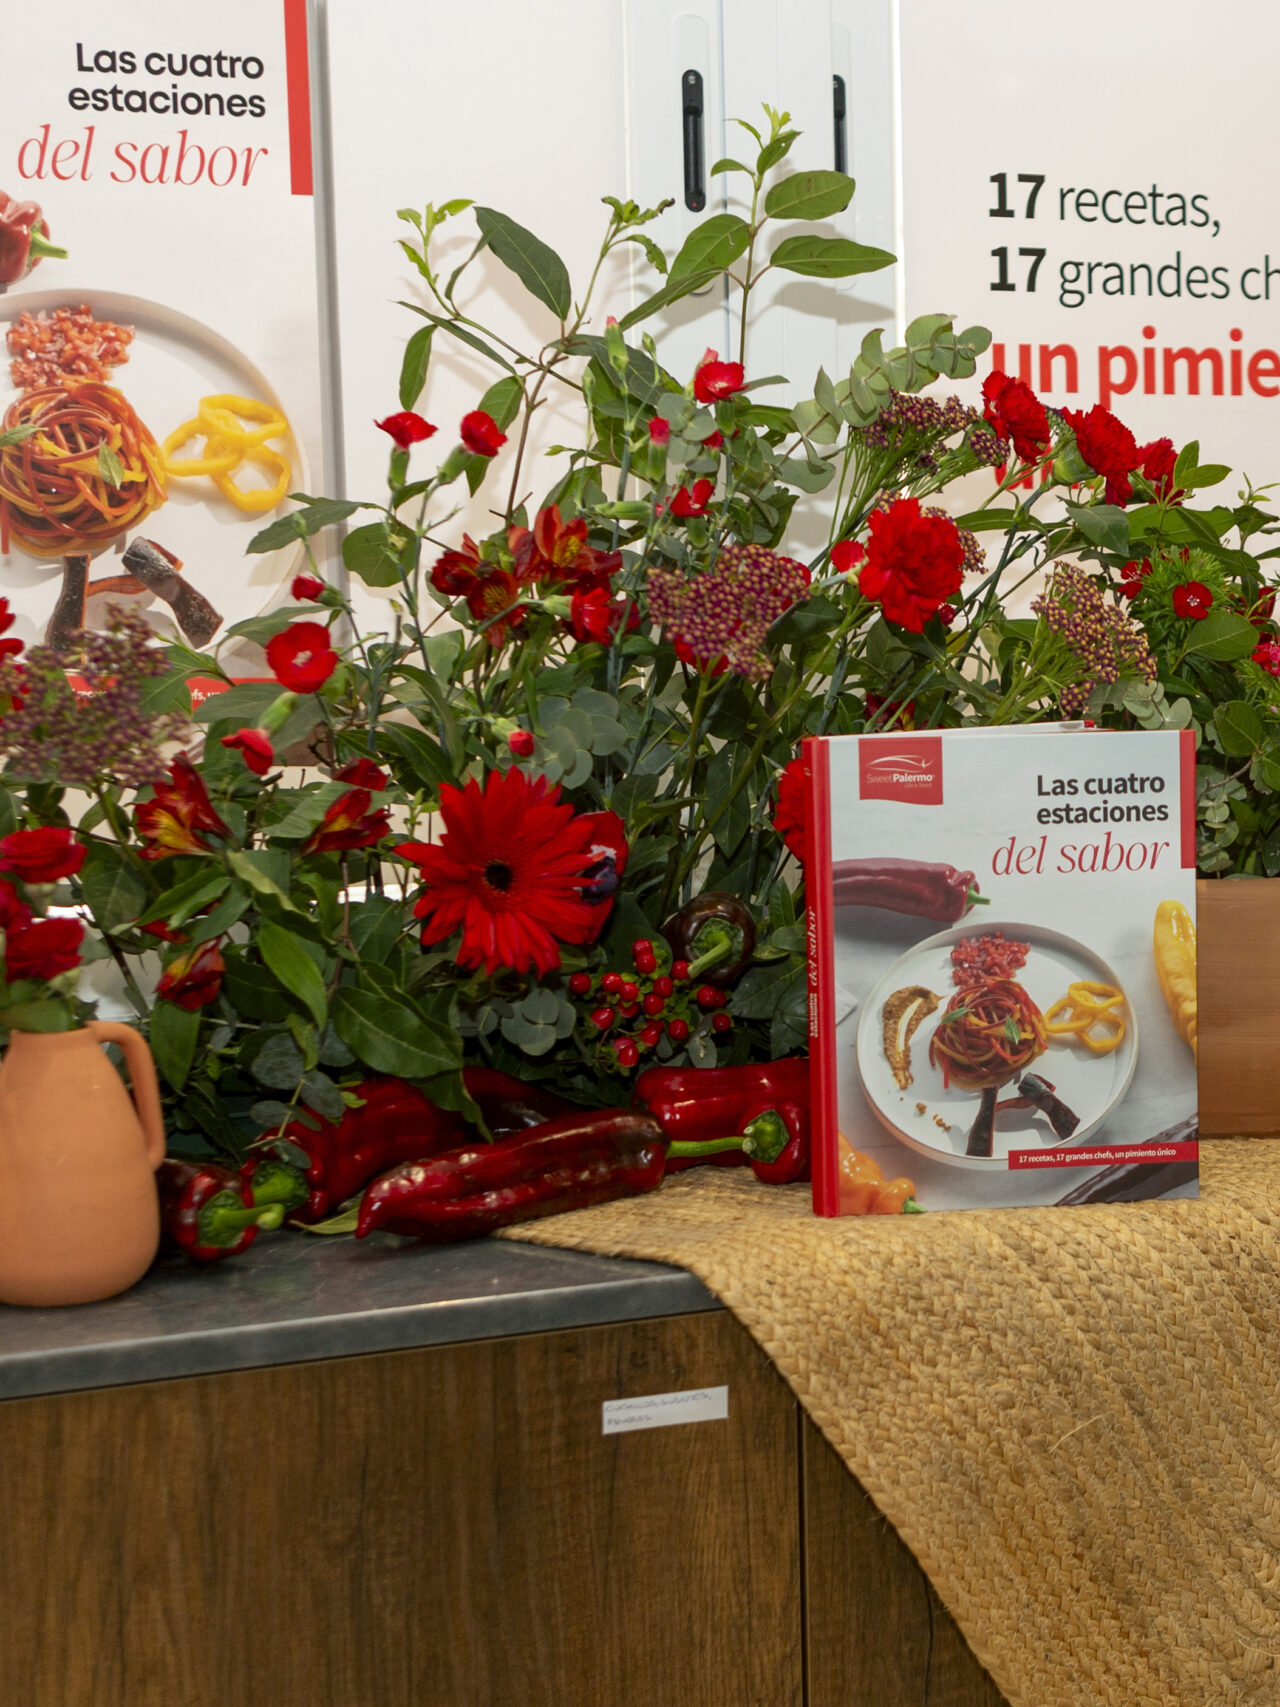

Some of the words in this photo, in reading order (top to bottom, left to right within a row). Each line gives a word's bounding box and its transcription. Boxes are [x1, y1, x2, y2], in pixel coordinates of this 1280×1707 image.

[77, 43, 137, 74] Las
[145, 50, 265, 80] cuatro
[68, 84, 266, 117] estaciones
[17, 123, 95, 182] del
[110, 129, 269, 187] sabor
[989, 172, 1046, 220] 17
[1059, 183, 1221, 237] recetas,
[990, 246, 1046, 293] 17
[1058, 251, 1231, 308] grandes
[1037, 774, 1078, 796] Las
[1083, 772, 1166, 795] cuatro
[1036, 799, 1169, 825] estaciones
[991, 835, 1047, 876] del
[1056, 831, 1171, 874] sabor
[807, 906, 817, 958] sabor
[808, 959, 818, 986] del
[1019, 1155, 1027, 1163] 17
[1028, 1154, 1055, 1163] recetas,
[1056, 1153, 1064, 1161] 17
[1065, 1153, 1093, 1162] grandes
[1094, 1150, 1114, 1160] chefs,
[1115, 1151, 1125, 1159] un
[1125, 1149, 1157, 1159] pimiento
[1157, 1147, 1176, 1156] único
